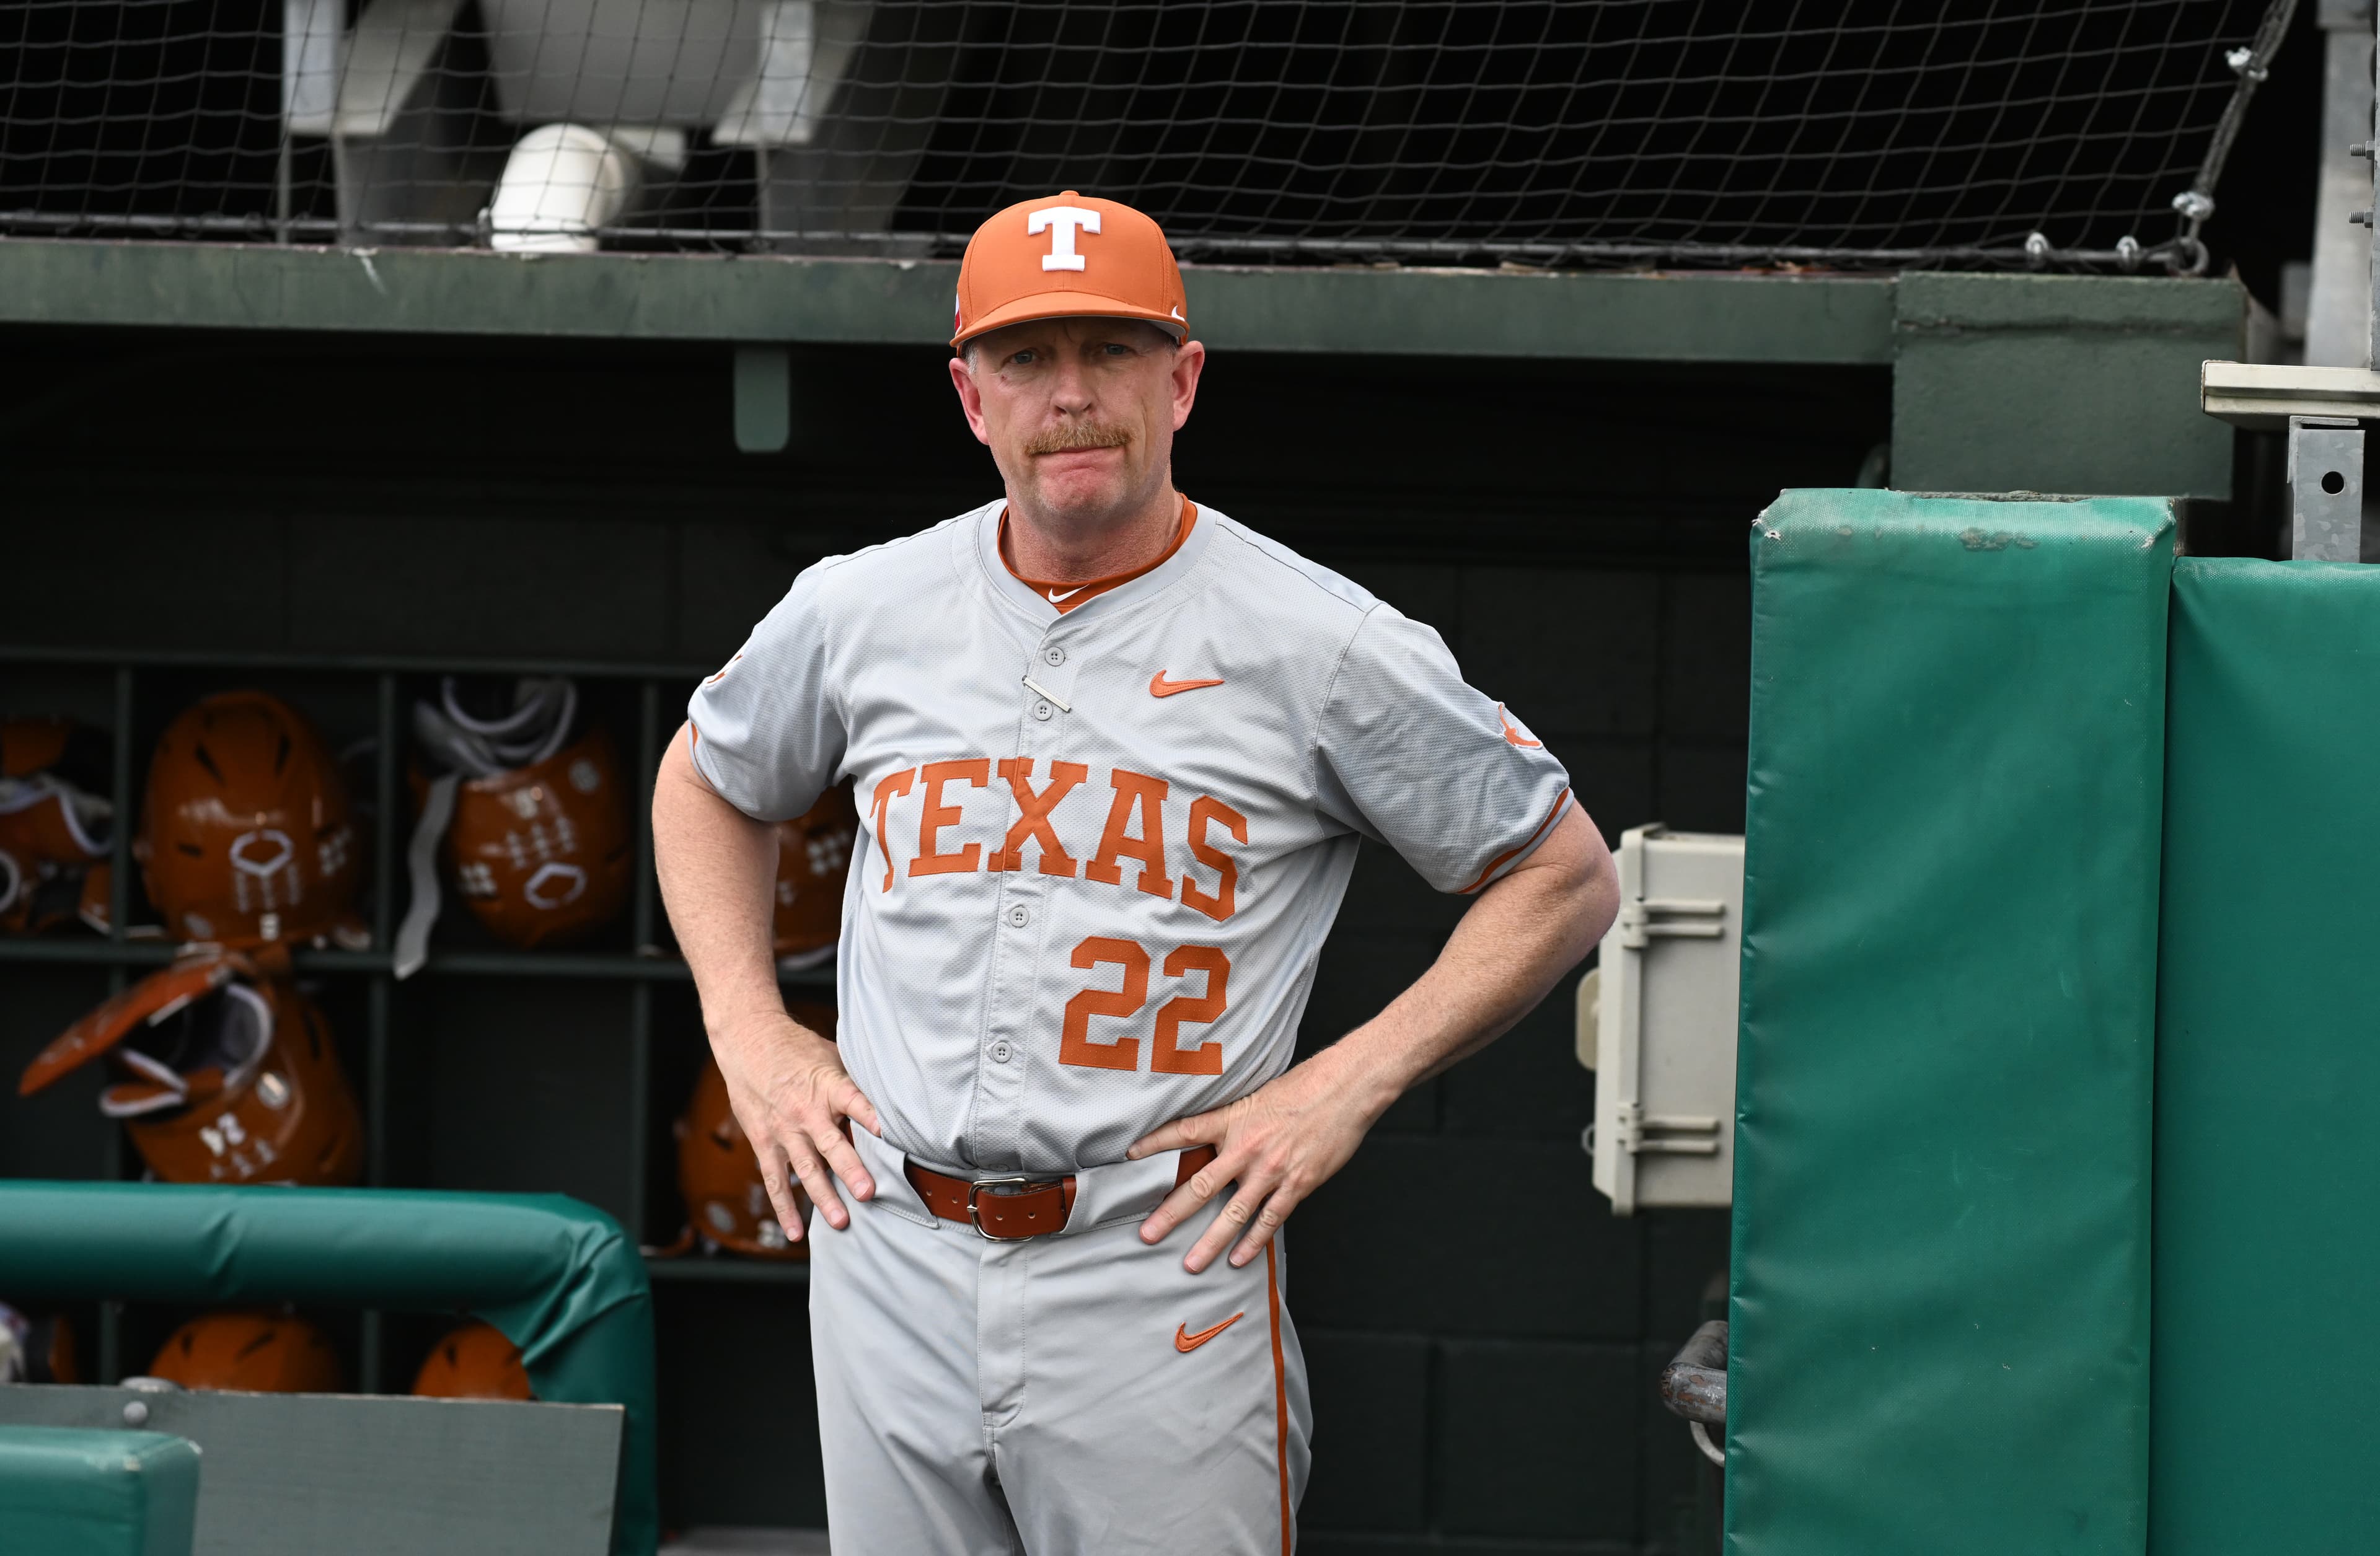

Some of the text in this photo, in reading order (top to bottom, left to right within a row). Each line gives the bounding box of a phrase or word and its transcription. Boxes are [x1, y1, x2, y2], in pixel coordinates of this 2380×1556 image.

[1028, 206, 1101, 271] T
[870, 757, 1248, 921] TEXAS
[1058, 936, 1231, 1075] 22
